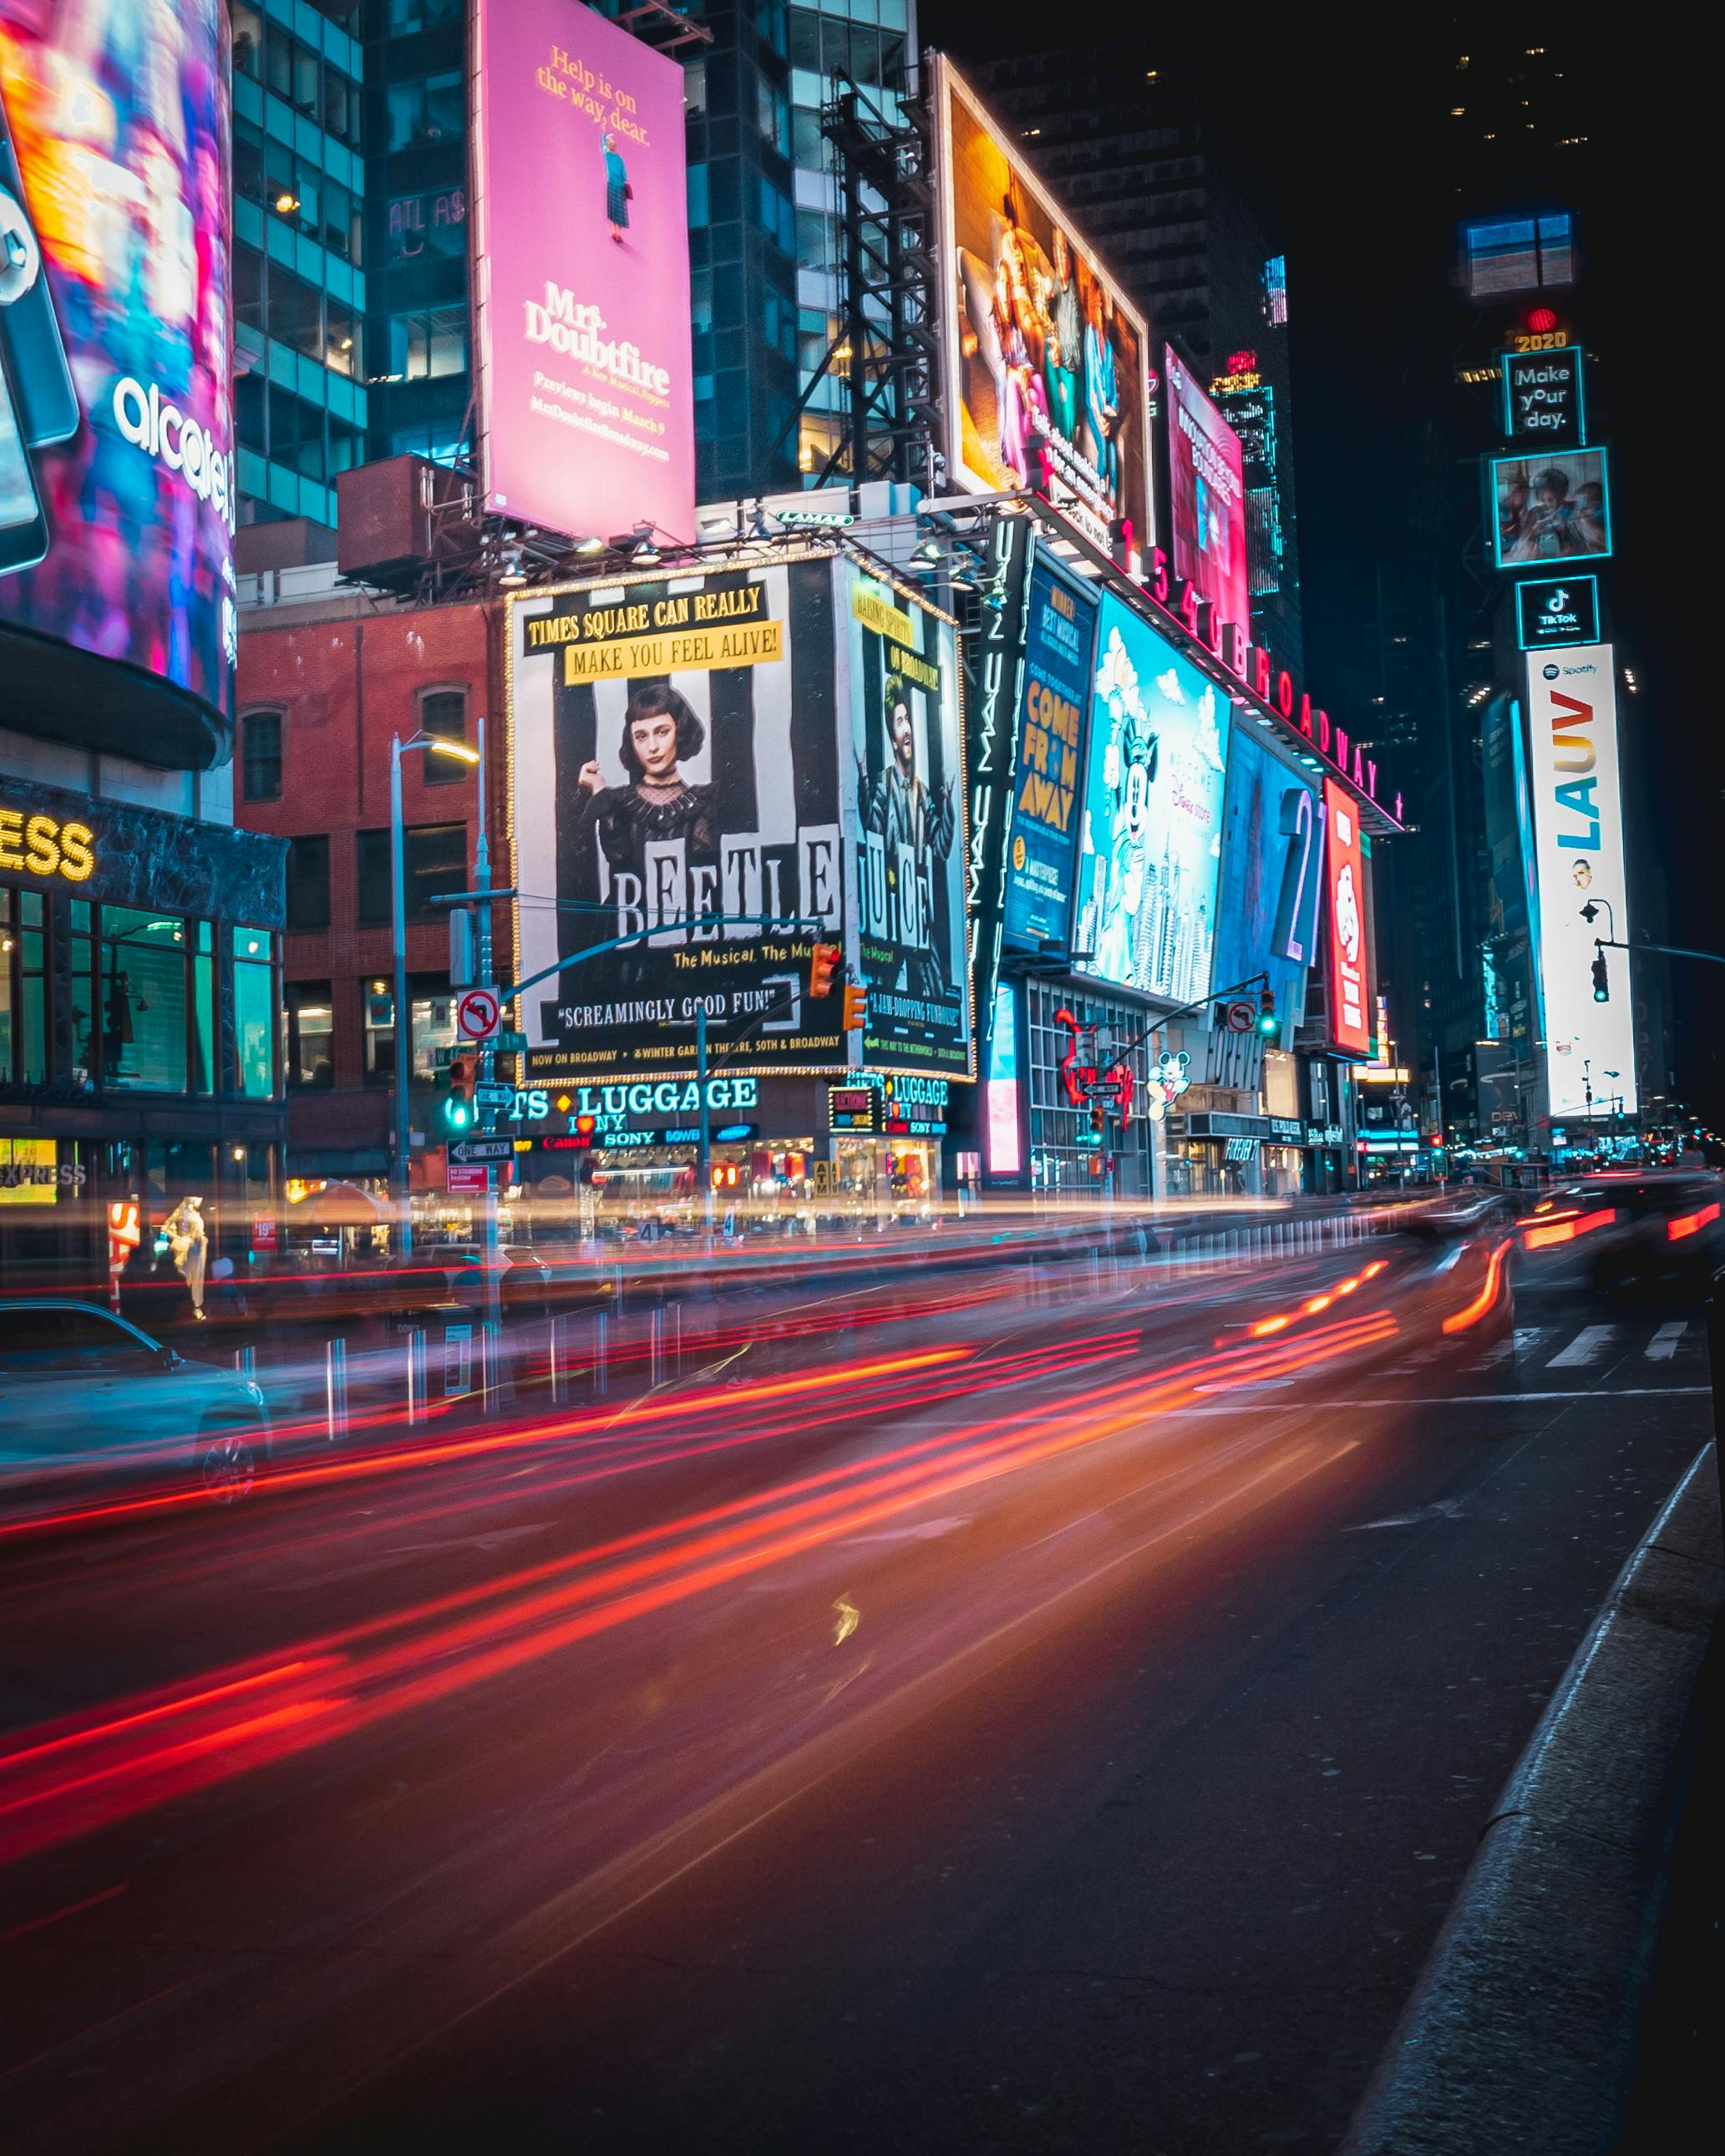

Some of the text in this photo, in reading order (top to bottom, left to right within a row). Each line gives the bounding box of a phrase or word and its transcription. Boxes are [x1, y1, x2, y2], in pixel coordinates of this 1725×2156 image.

[551, 45, 637, 114] Help is on
[536, 67, 651, 147] the way, dear.
[545, 281, 607, 329] Mrs.
[524, 300, 671, 395] Doubtfire
[1516, 332, 1567, 353] 2020
[1516, 366, 1570, 386] Make
[532, 371, 587, 403] Previews
[588, 393, 620, 419] begin
[621, 408, 658, 432] March
[658, 422, 666, 436] 9
[1520, 388, 1567, 411] your
[1526, 411, 1566, 429] day.
[1122, 518, 1221, 652] 1540
[529, 586, 762, 647] TIMES SQUARE CAN REALLY
[1540, 613, 1577, 625] TikTok
[573, 628, 778, 675] MAKE YOU FEEL ALIVE!
[1563, 663, 1598, 675] Spotify
[1027, 680, 1080, 747] COME
[1229, 622, 1377, 799] BROADWAY
[1550, 690, 1601, 850] LAUV
[1018, 770, 1074, 833] AWAY
[614, 833, 840, 949] BEETLE
[859, 835, 930, 949] JUICE
[673, 952, 698, 969] The
[761, 944, 787, 961] The
[532, 1049, 618, 1067] NOW ON BROADWAY
[642, 1046, 675, 1059] WINTER
[756, 1038, 778, 1051] 50TH
[789, 1035, 840, 1048] BROADWAY
[577, 1078, 758, 1115] LUGGAGE
[892, 1075, 948, 1106] LUGGAGE
[594, 1114, 627, 1133] NY
[911, 1122, 931, 1134] SONY
[458, 1144, 477, 1157] ONE
[485, 1142, 505, 1155] WAY
[543, 1137, 590, 1149] Canon
[605, 1132, 656, 1147] SONY
[1225, 1138, 1252, 1160] FOREVER
[459, 1167, 484, 1175] STANDING
[816, 1163, 828, 1193] ATM
